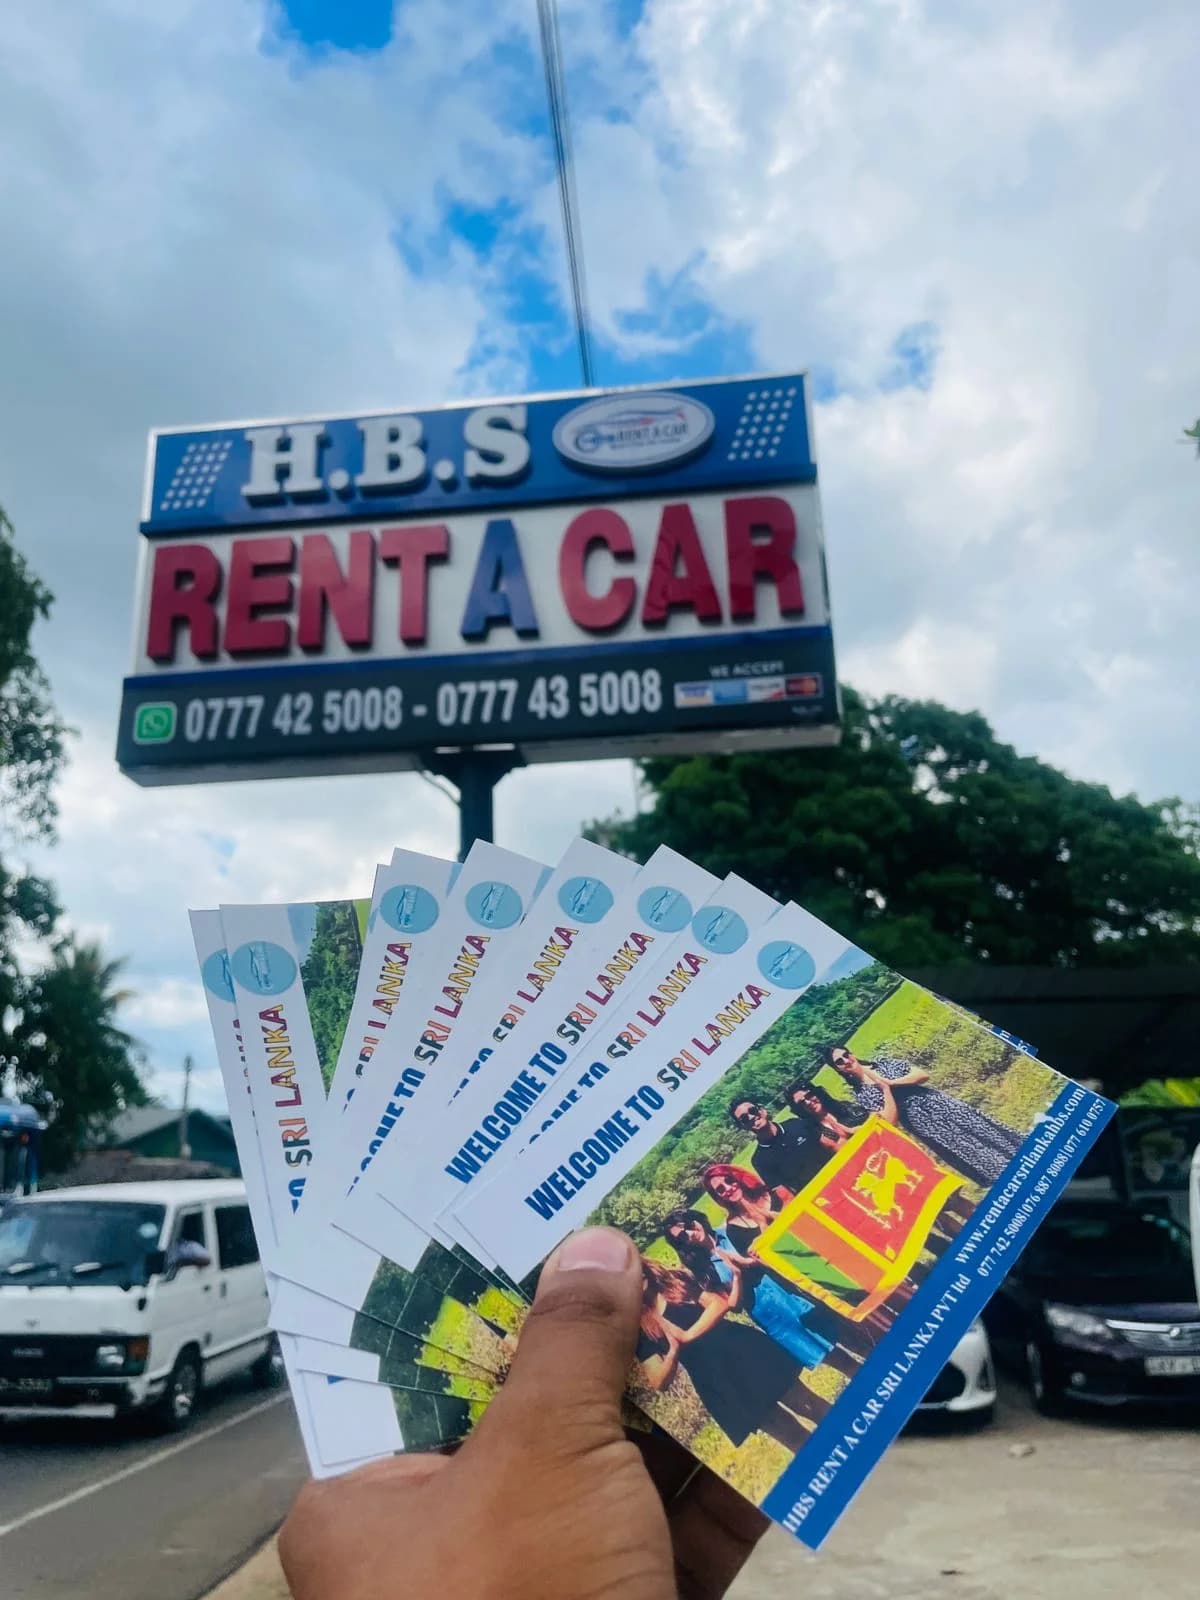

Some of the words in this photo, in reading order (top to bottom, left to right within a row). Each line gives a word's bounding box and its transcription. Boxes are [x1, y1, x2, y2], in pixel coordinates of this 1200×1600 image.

[242, 404, 530, 499] H.B.S
[146, 523, 449, 662] RENT
[460, 518, 540, 641] A
[557, 496, 805, 634] CAR
[732, 660, 784, 676] ACCEPT
[185, 696, 261, 741] 0777
[271, 692, 312, 735] 42
[322, 686, 403, 732] 5008
[437, 680, 515, 728] 0777
[527, 676, 569, 720] 43
[579, 669, 662, 715] 5008
[516, 925, 579, 1004] LANKA
[414, 1020, 452, 1067] SRI
[434, 935, 491, 1019] LANKA
[606, 1022, 648, 1059] SRI
[636, 951, 709, 1027] LANKA
[258, 1003, 302, 1107] LANKA
[444, 1067, 546, 1184] WELCOME
[529, 1041, 568, 1078] TO
[556, 1002, 598, 1046] SRI
[585, 931, 655, 1006] LANKA
[524, 1095, 641, 1221] WELCOME
[624, 1084, 665, 1121] TO
[657, 1049, 701, 1092] SRI
[691, 983, 771, 1056] LANKA
[278, 1117, 312, 1167] SRI
[955, 1087, 1087, 1264] www.rentacarsrilankahbs.com
[977, 1255, 997, 1278] 077
[990, 1236, 1011, 1257] 742
[1034, 1175, 1053, 1196] 887
[1075, 1119, 1094, 1137] 610
[930, 1290, 959, 1324] PVT
[951, 1273, 972, 1294] ltd
[898, 1321, 940, 1374] LANKA
[851, 1398, 884, 1436] CAR
[876, 1368, 903, 1401] SRI
[808, 1444, 850, 1496] RENT
[843, 1434, 861, 1451] A
[782, 1493, 816, 1533] HBS
